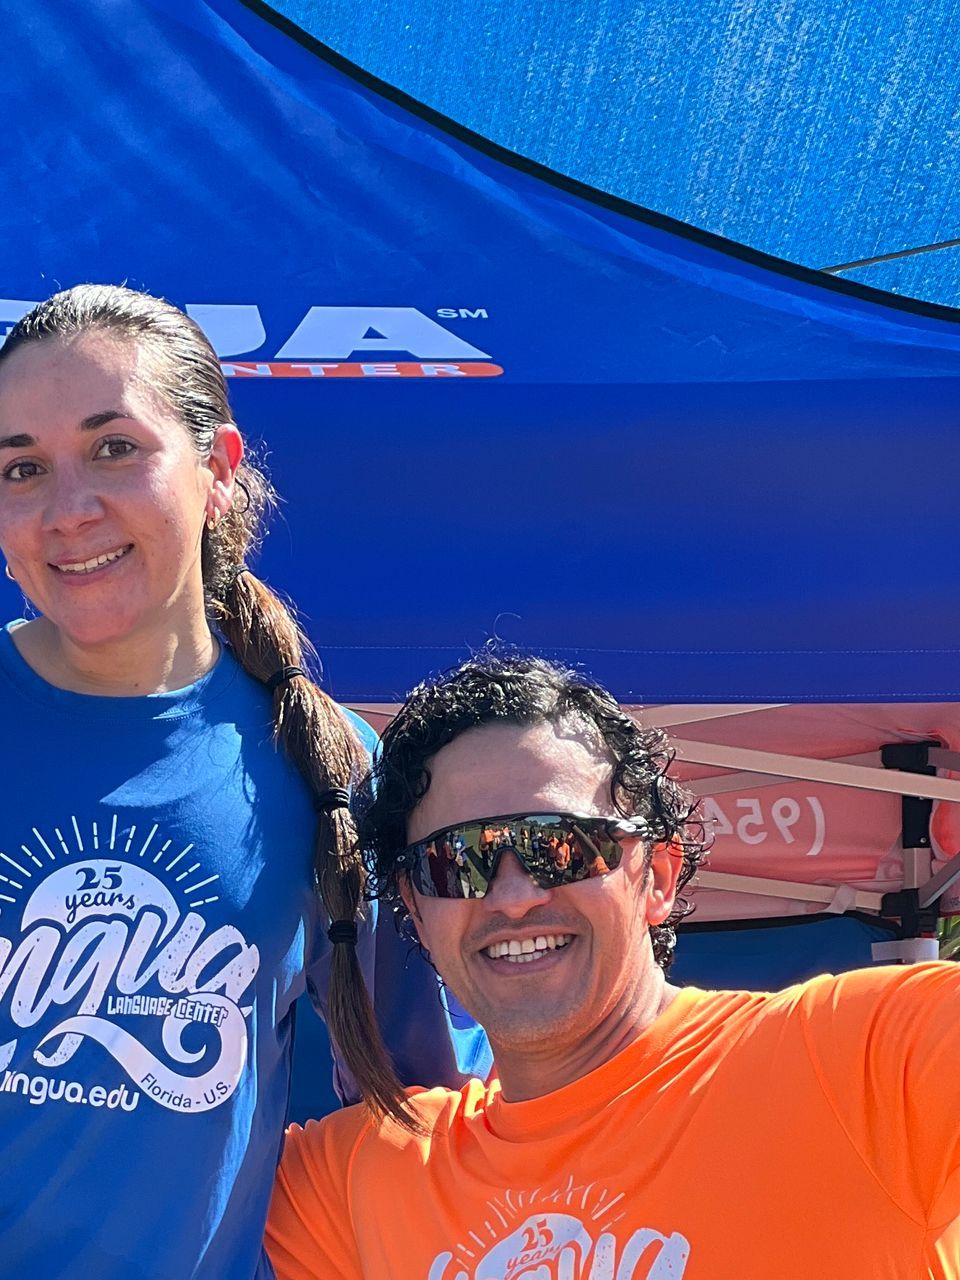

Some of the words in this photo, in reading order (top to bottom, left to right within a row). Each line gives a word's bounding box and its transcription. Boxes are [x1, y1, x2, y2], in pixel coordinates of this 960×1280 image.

[75, 866, 123, 891] 25
[65, 891, 135, 923] years
[107, 995, 172, 1016] LANGUAGE
[176, 996, 228, 1026] CENTER
[0, 1070, 140, 1112] lingua.edu
[141, 1073, 192, 1108] Florida
[204, 1082, 231, 1106] U.S.
[521, 1219, 554, 1250] 25
